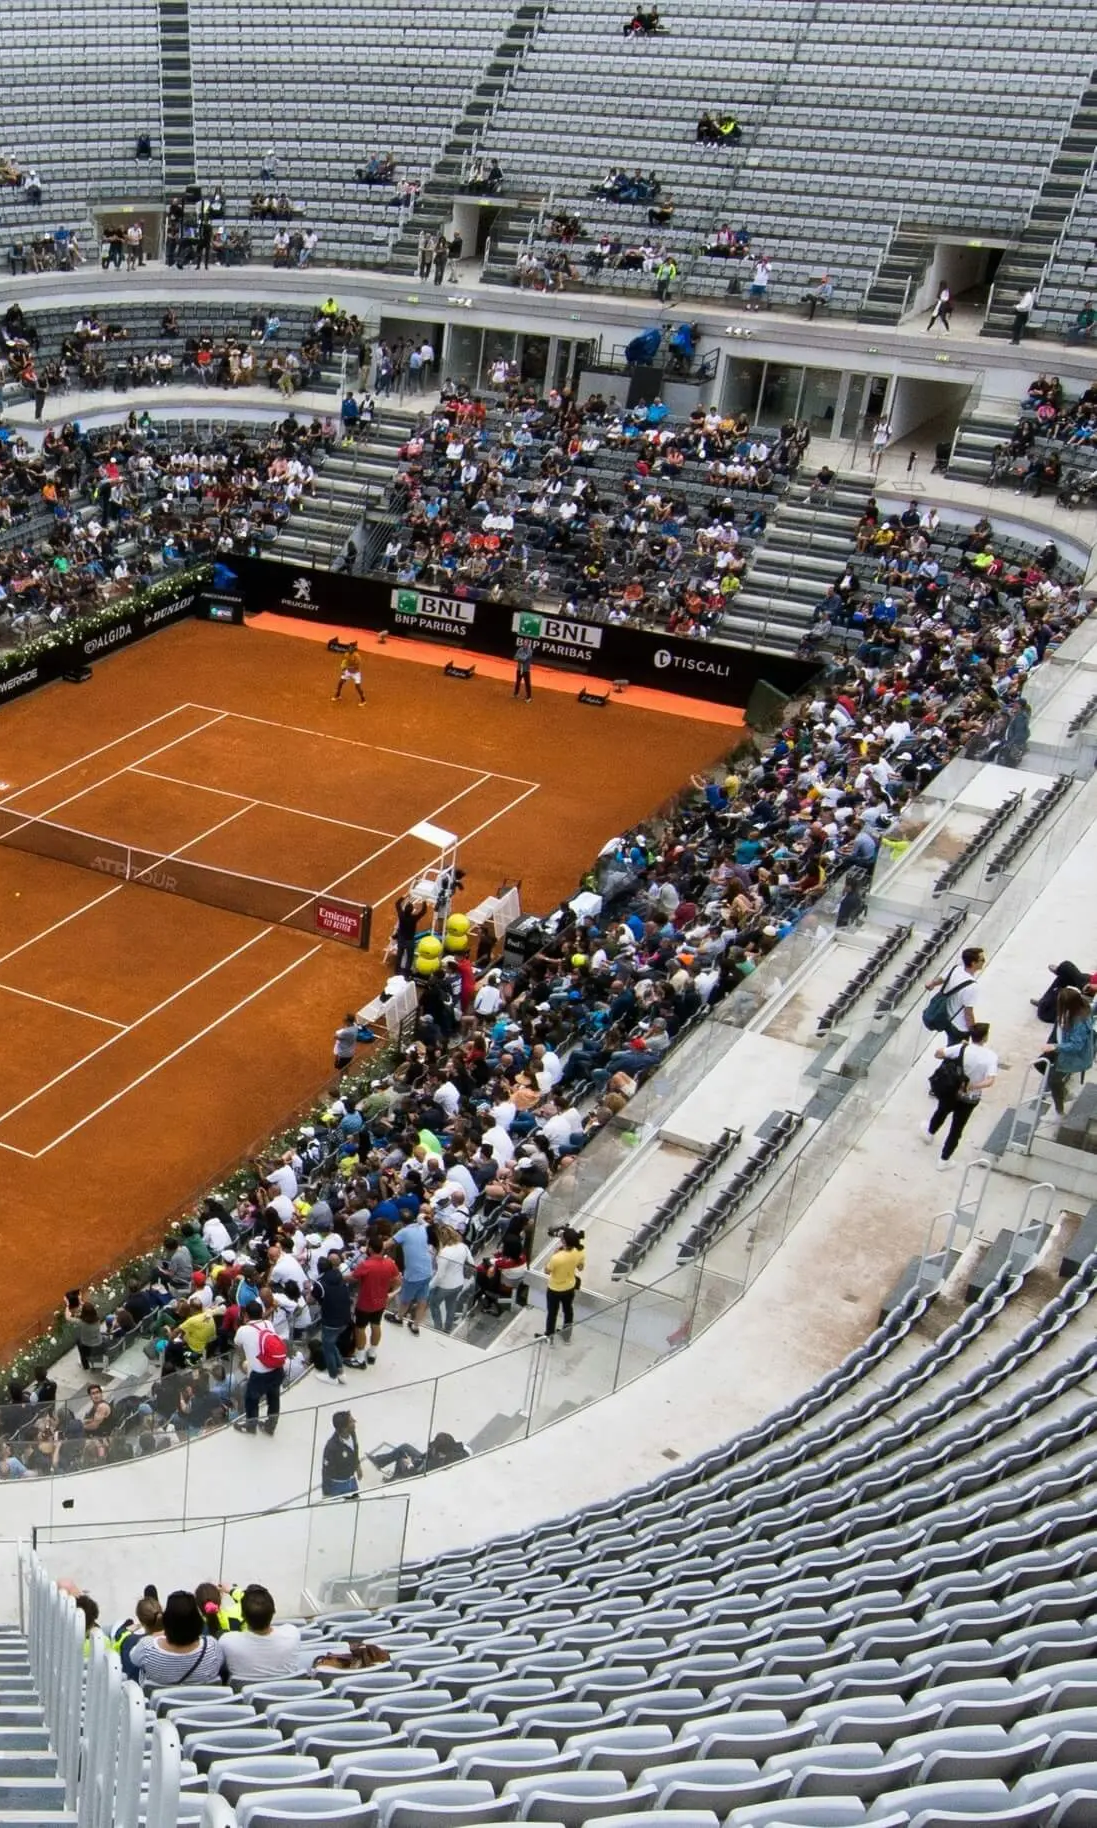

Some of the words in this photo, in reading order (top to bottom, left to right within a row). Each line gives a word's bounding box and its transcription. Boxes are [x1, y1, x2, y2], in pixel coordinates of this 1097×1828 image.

[152, 595, 195, 622] DUNLOP
[281, 598, 320, 611] PEUGEOT
[421, 594, 469, 620] BNL
[96, 624, 132, 649] ALGIDA
[395, 614, 417, 625] BNP
[419, 618, 467, 636] PARIBAS
[545, 620, 594, 645] BNL
[542, 643, 592, 661] PARIBAS
[673, 656, 730, 677] TISCALI
[90, 856, 127, 876] ATP
[130, 865, 178, 892] TOUR
[319, 907, 357, 926] Emirates
